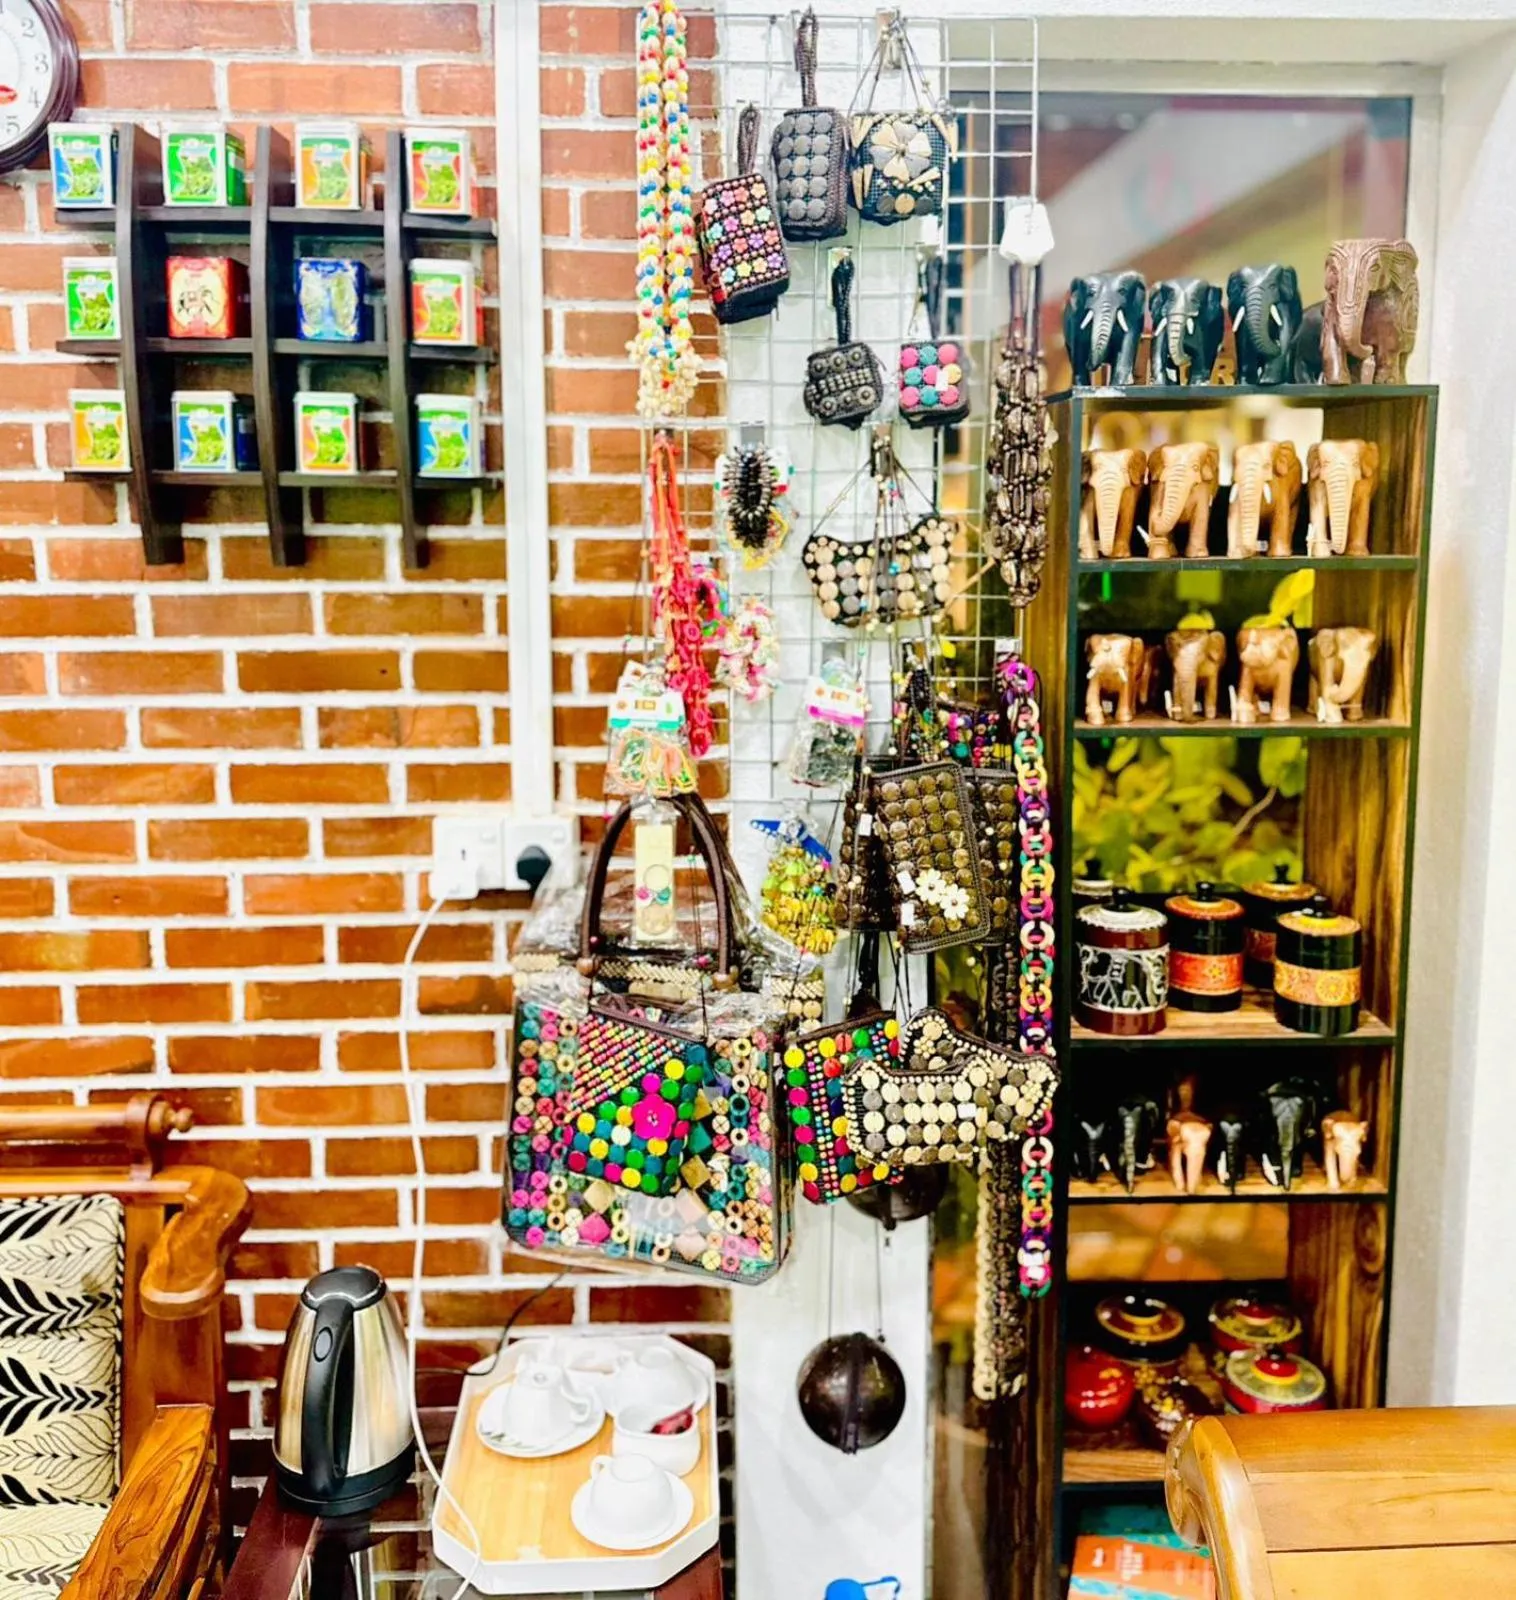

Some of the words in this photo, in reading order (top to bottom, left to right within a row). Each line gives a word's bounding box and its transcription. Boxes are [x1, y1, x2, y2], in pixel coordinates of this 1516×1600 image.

[21, 18, 36, 38] 2
[34, 53, 49, 74] 3
[27, 86, 42, 109] 4
[6, 115, 20, 136] 5
